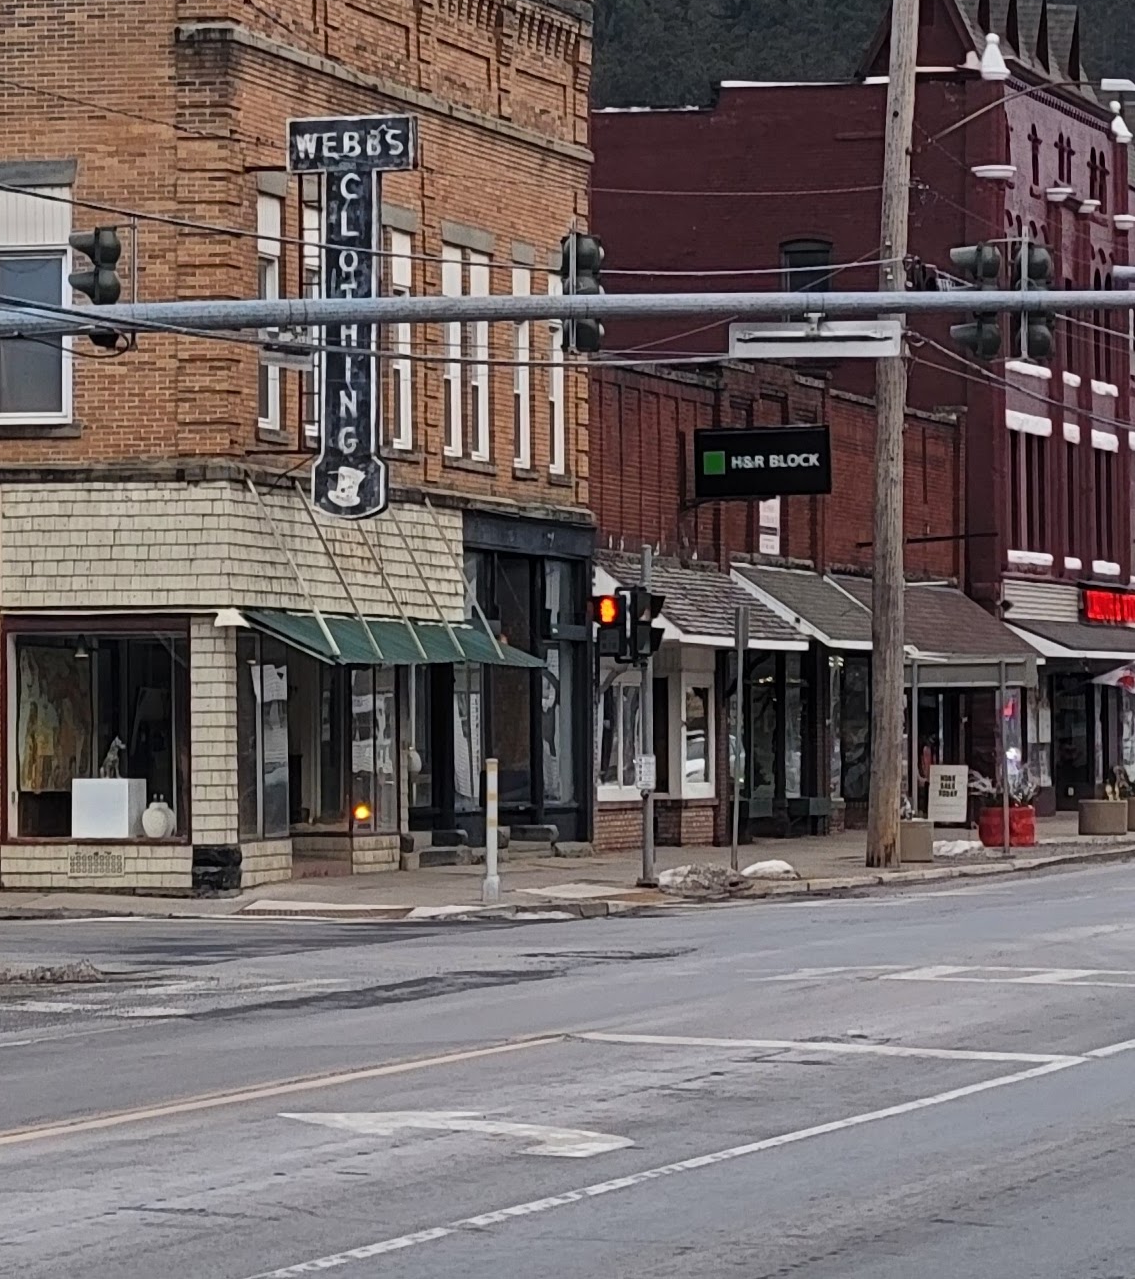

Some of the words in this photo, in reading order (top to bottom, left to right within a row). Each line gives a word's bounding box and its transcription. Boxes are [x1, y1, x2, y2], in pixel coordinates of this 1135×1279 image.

[337, 172, 361, 455] CLOTHING
[731, 455, 765, 469] H&R
[769, 453, 820, 468] BLOCK
